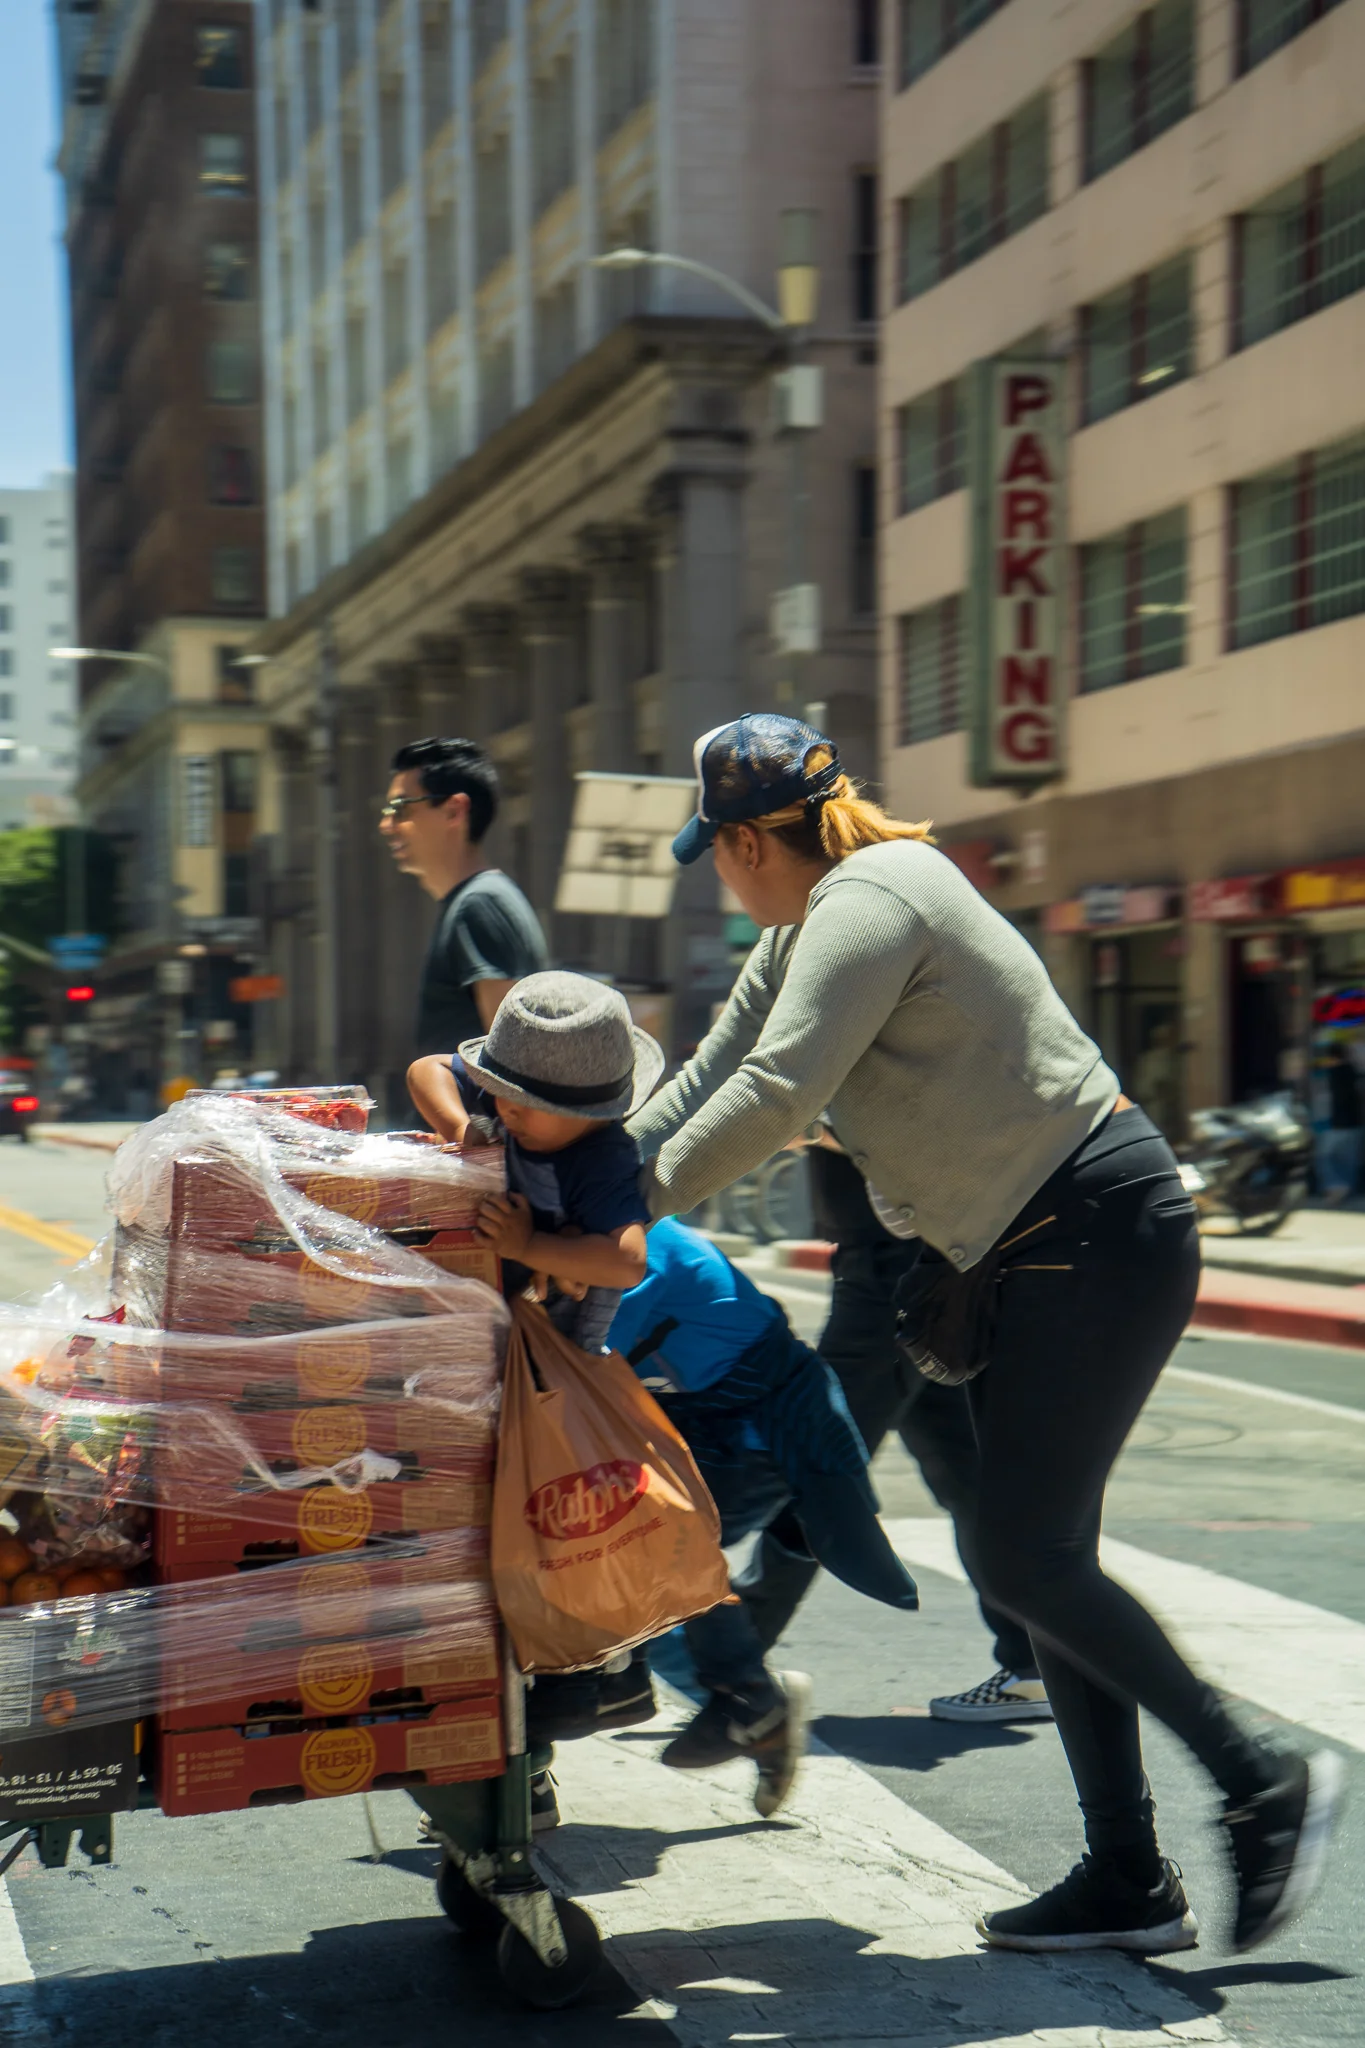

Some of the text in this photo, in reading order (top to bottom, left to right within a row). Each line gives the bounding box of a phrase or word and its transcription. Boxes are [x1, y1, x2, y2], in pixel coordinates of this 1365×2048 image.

[998, 375, 1054, 764] PARKING
[526, 1466, 638, 1537] Ralphs
[303, 1507, 369, 1526] FRESH
[539, 1555, 574, 1571] FRESH
[577, 1548, 604, 1564] FOR
[305, 1747, 372, 1771] FRESH
[68, 1763, 123, 1781] 50-65°F
[55, 1785, 66, 1793] de
[69, 1791, 100, 1800] Storage
